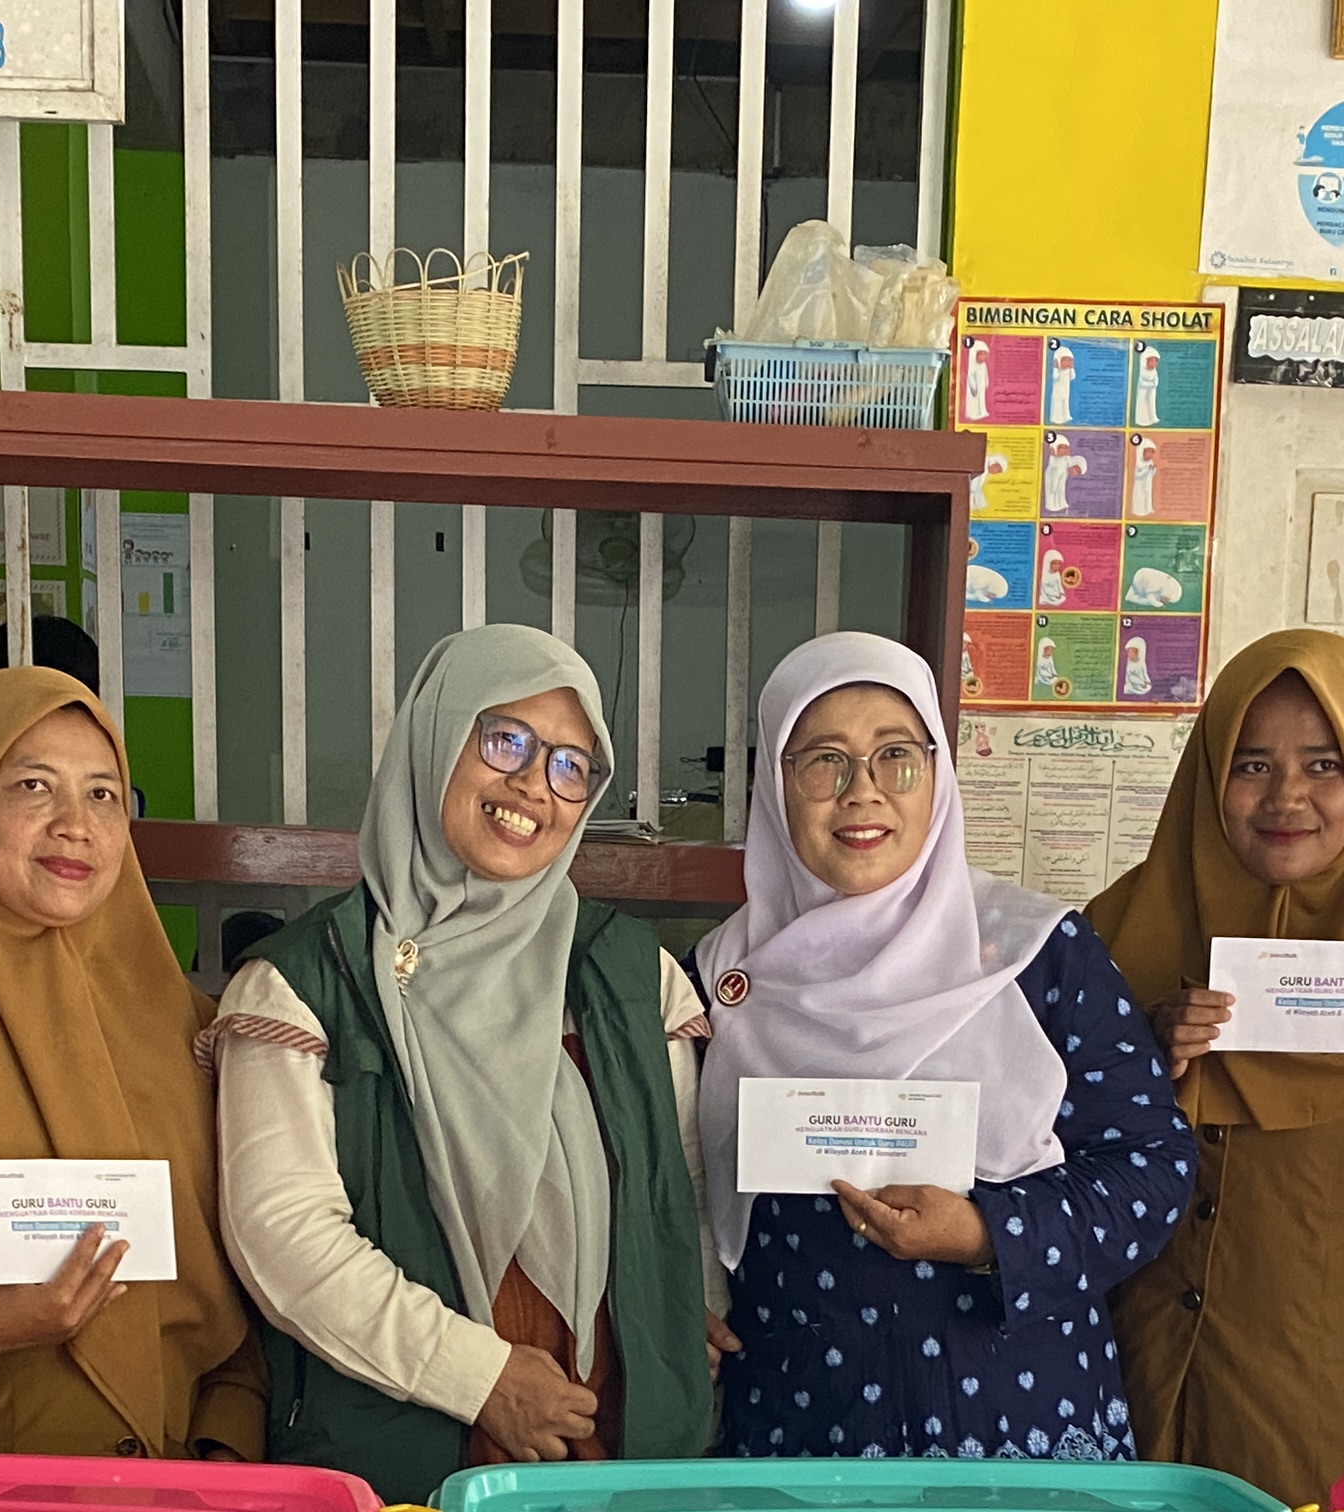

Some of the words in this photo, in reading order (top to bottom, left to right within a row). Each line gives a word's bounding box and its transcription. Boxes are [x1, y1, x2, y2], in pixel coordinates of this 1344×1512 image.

[966, 307, 1077, 325] BIMBINGAN
[1084, 310, 1133, 327] CARA
[1140, 311, 1212, 329] SHOLAT
[1280, 977, 1311, 986] GURU
[809, 1116, 840, 1124] GURU
[843, 1116, 881, 1126] BANTU
[885, 1117, 916, 1127] GURU
[12, 1198, 44, 1209] GURU
[47, 1198, 83, 1208] BANTU
[86, 1199, 116, 1209] GURU
